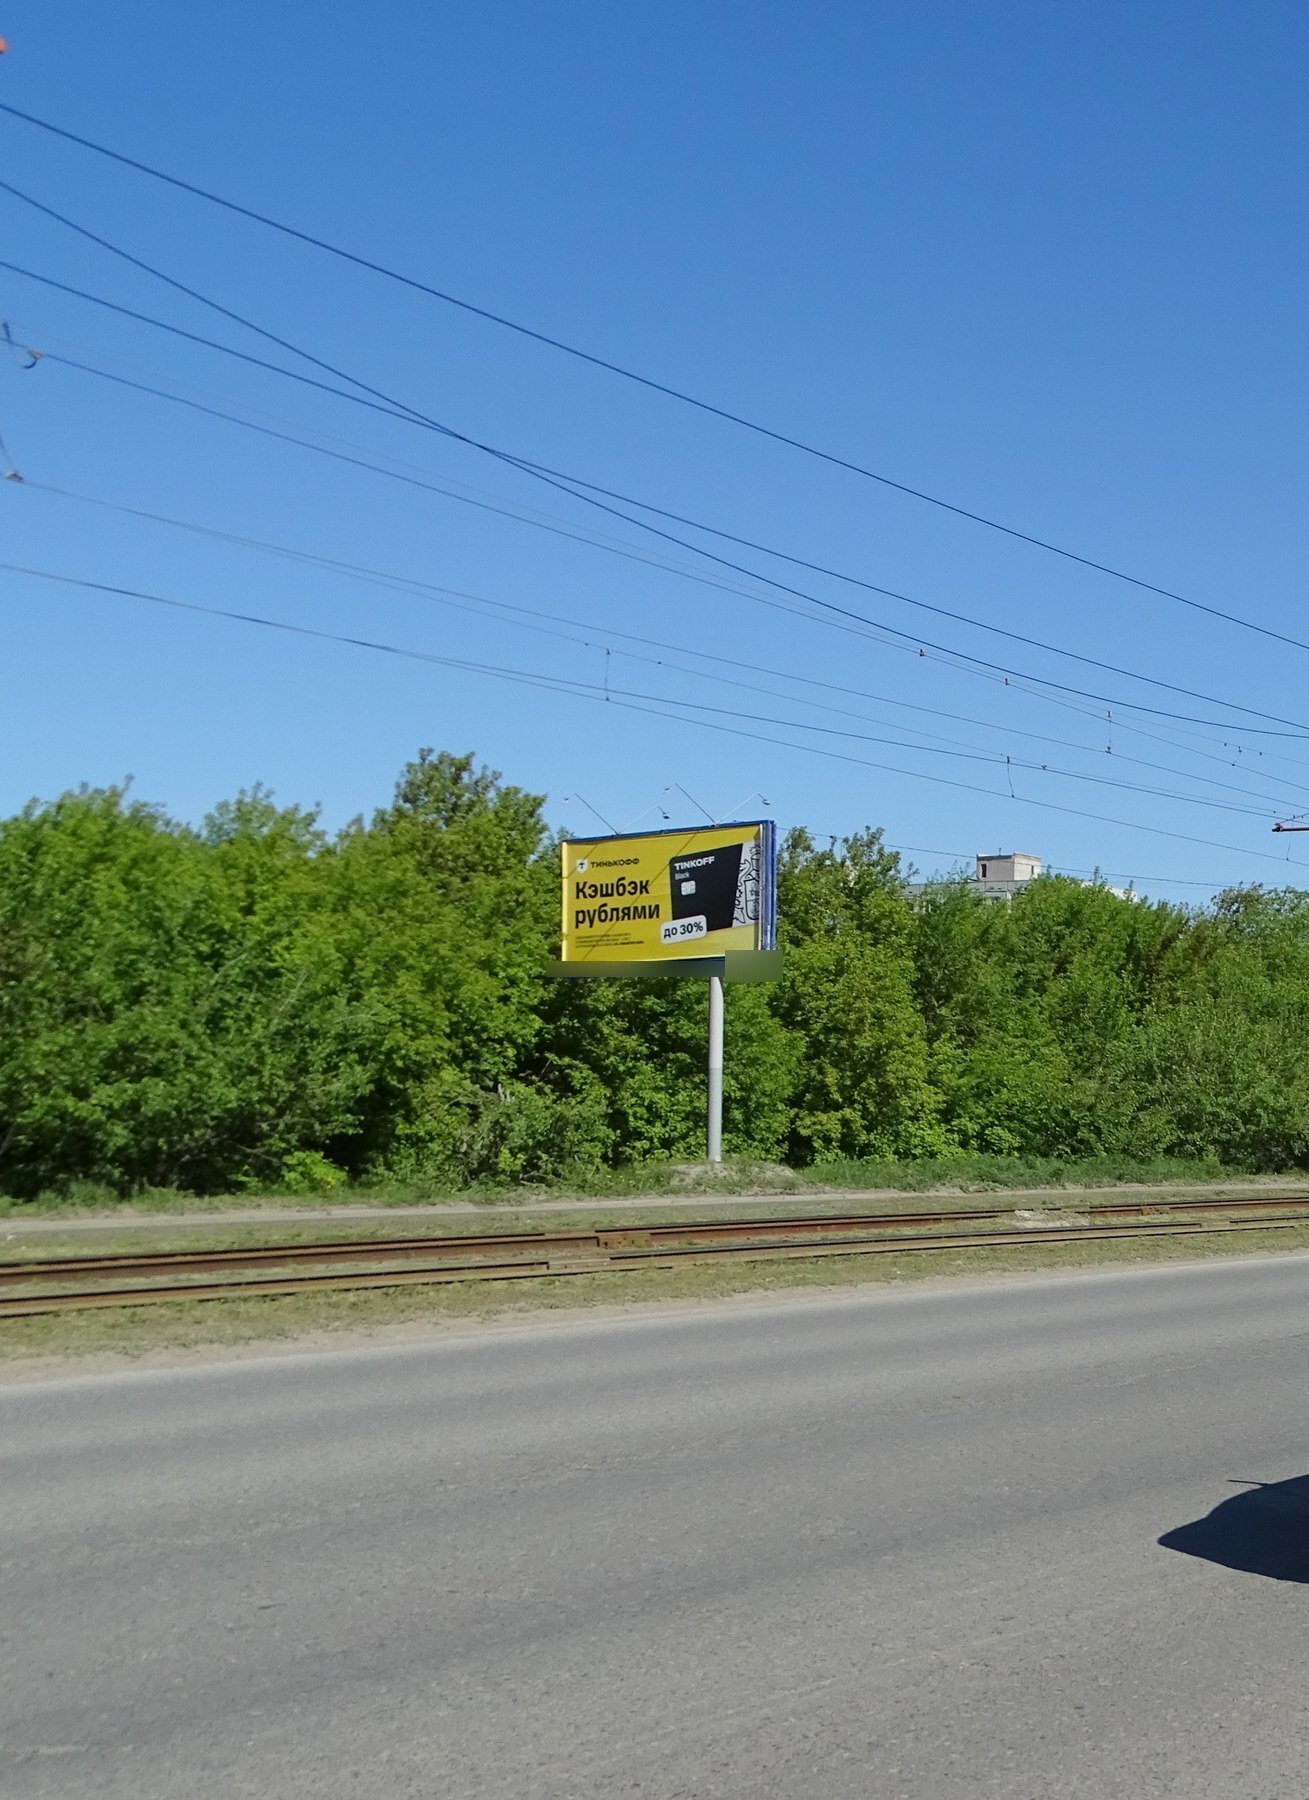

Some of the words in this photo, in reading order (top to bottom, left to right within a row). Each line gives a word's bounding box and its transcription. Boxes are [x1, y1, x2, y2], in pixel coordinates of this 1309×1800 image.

[590, 858, 640, 868] ТИНЬКОФФ
[674, 856, 715, 871] TINKOFF
[575, 876, 650, 899] Кэшбэк
[575, 903, 660, 929] рублями
[663, 927, 678, 939] до
[680, 921, 704, 935] 30%
